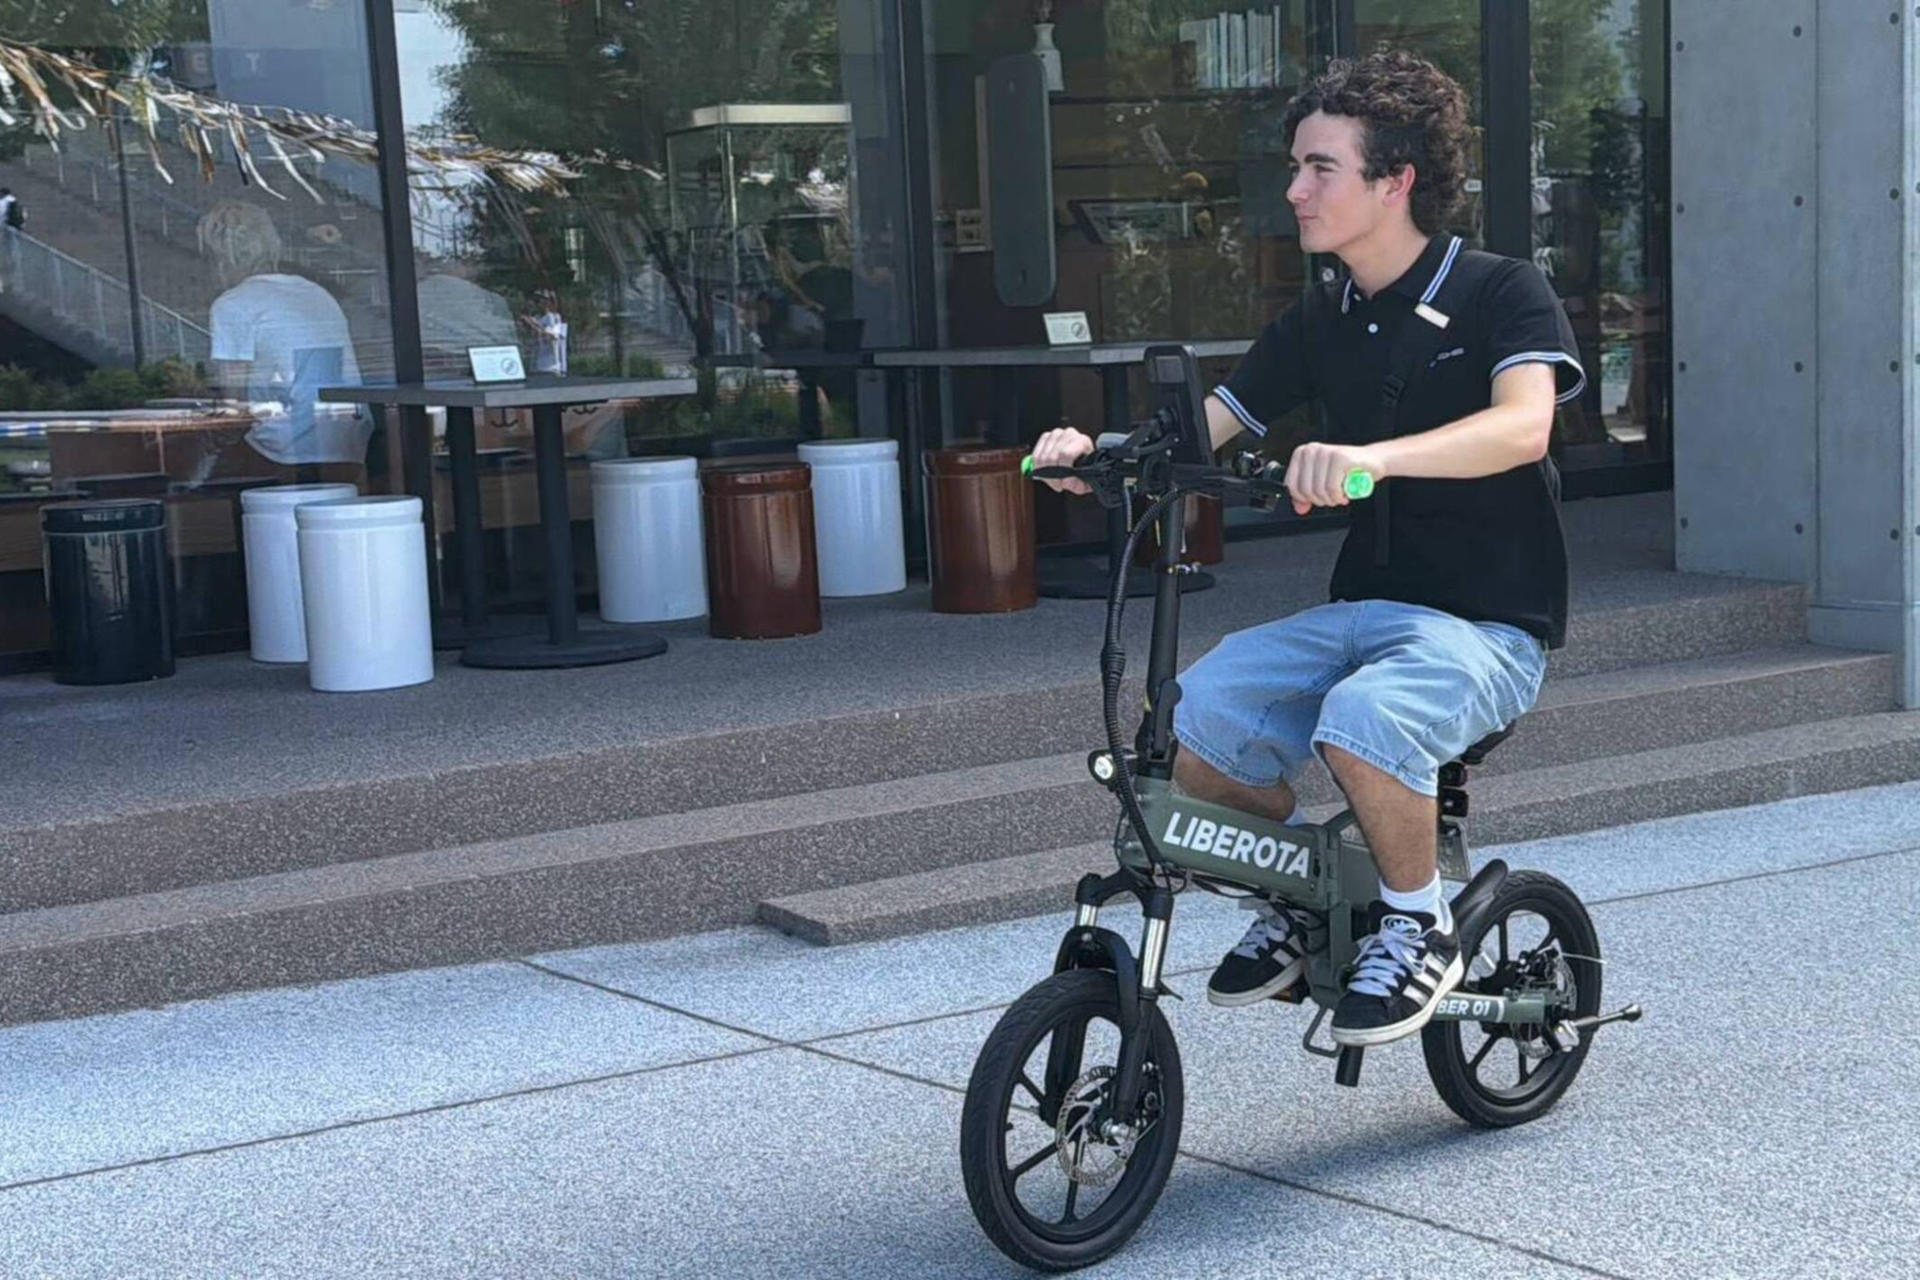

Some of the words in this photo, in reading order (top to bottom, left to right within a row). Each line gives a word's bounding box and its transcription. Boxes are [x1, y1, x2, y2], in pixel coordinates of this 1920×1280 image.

[1163, 811, 1310, 879] LIBEROTA
[1435, 999, 1470, 1015] BER
[1472, 1000, 1491, 1017] 01
